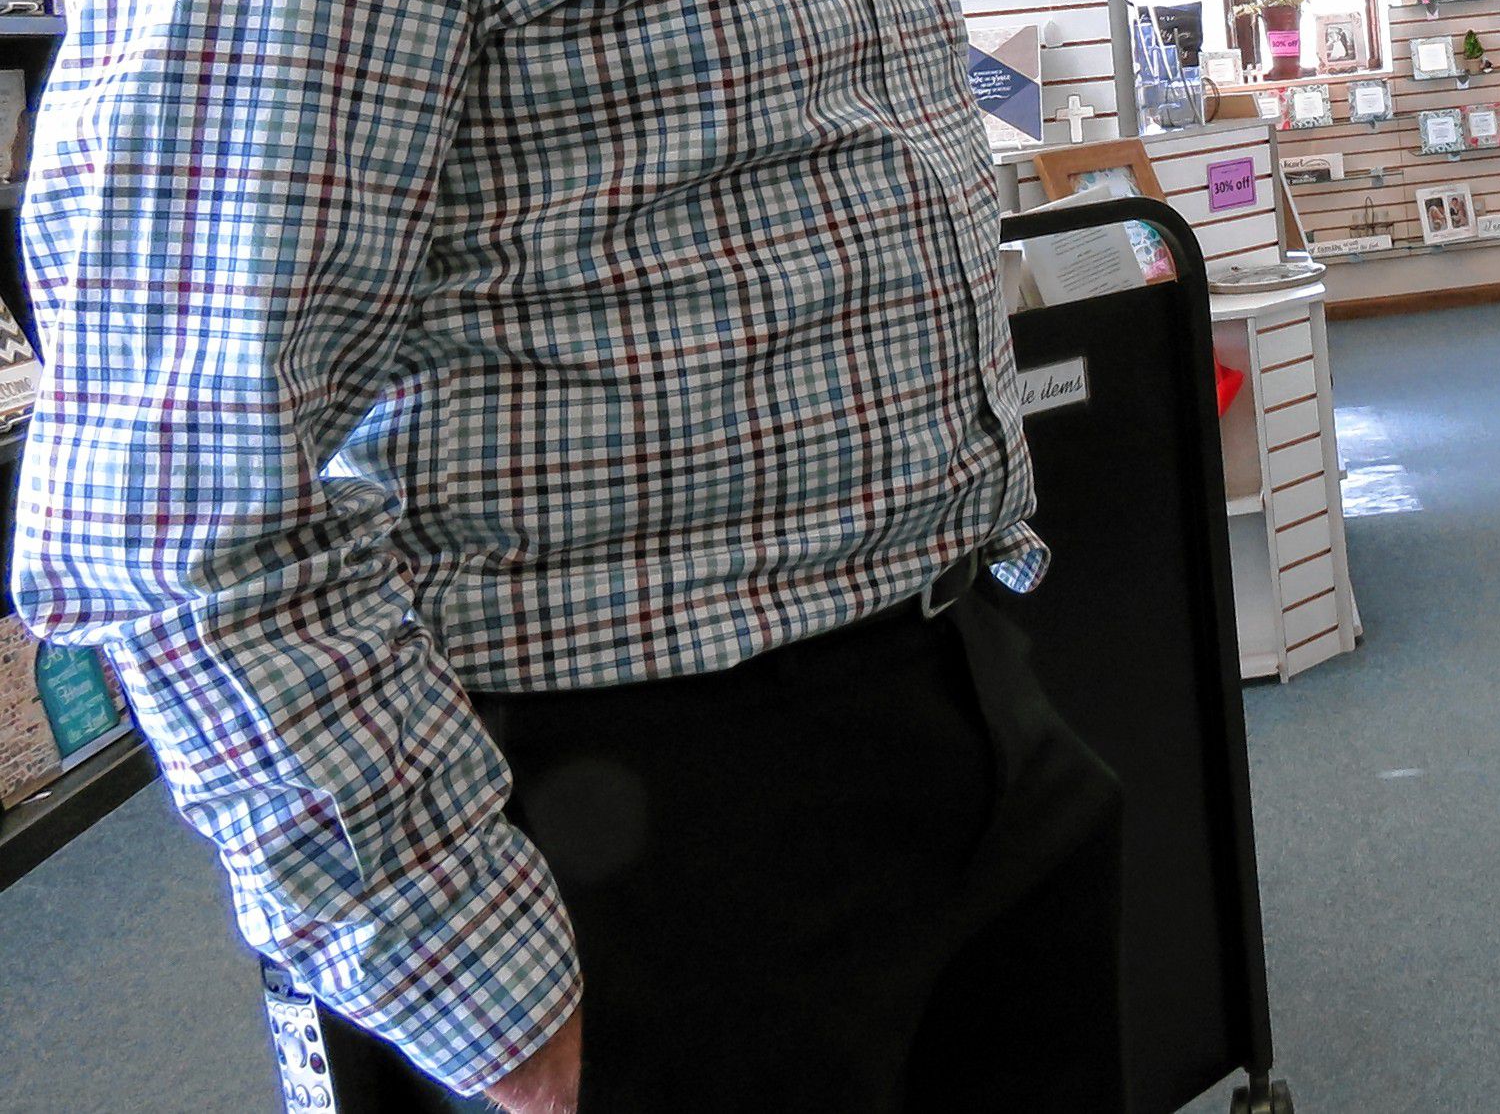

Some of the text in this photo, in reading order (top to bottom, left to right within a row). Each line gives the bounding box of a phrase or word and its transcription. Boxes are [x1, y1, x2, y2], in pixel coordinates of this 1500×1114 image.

[1214, 176, 1251, 195] 30% off
[1041, 375, 1083, 401] items
